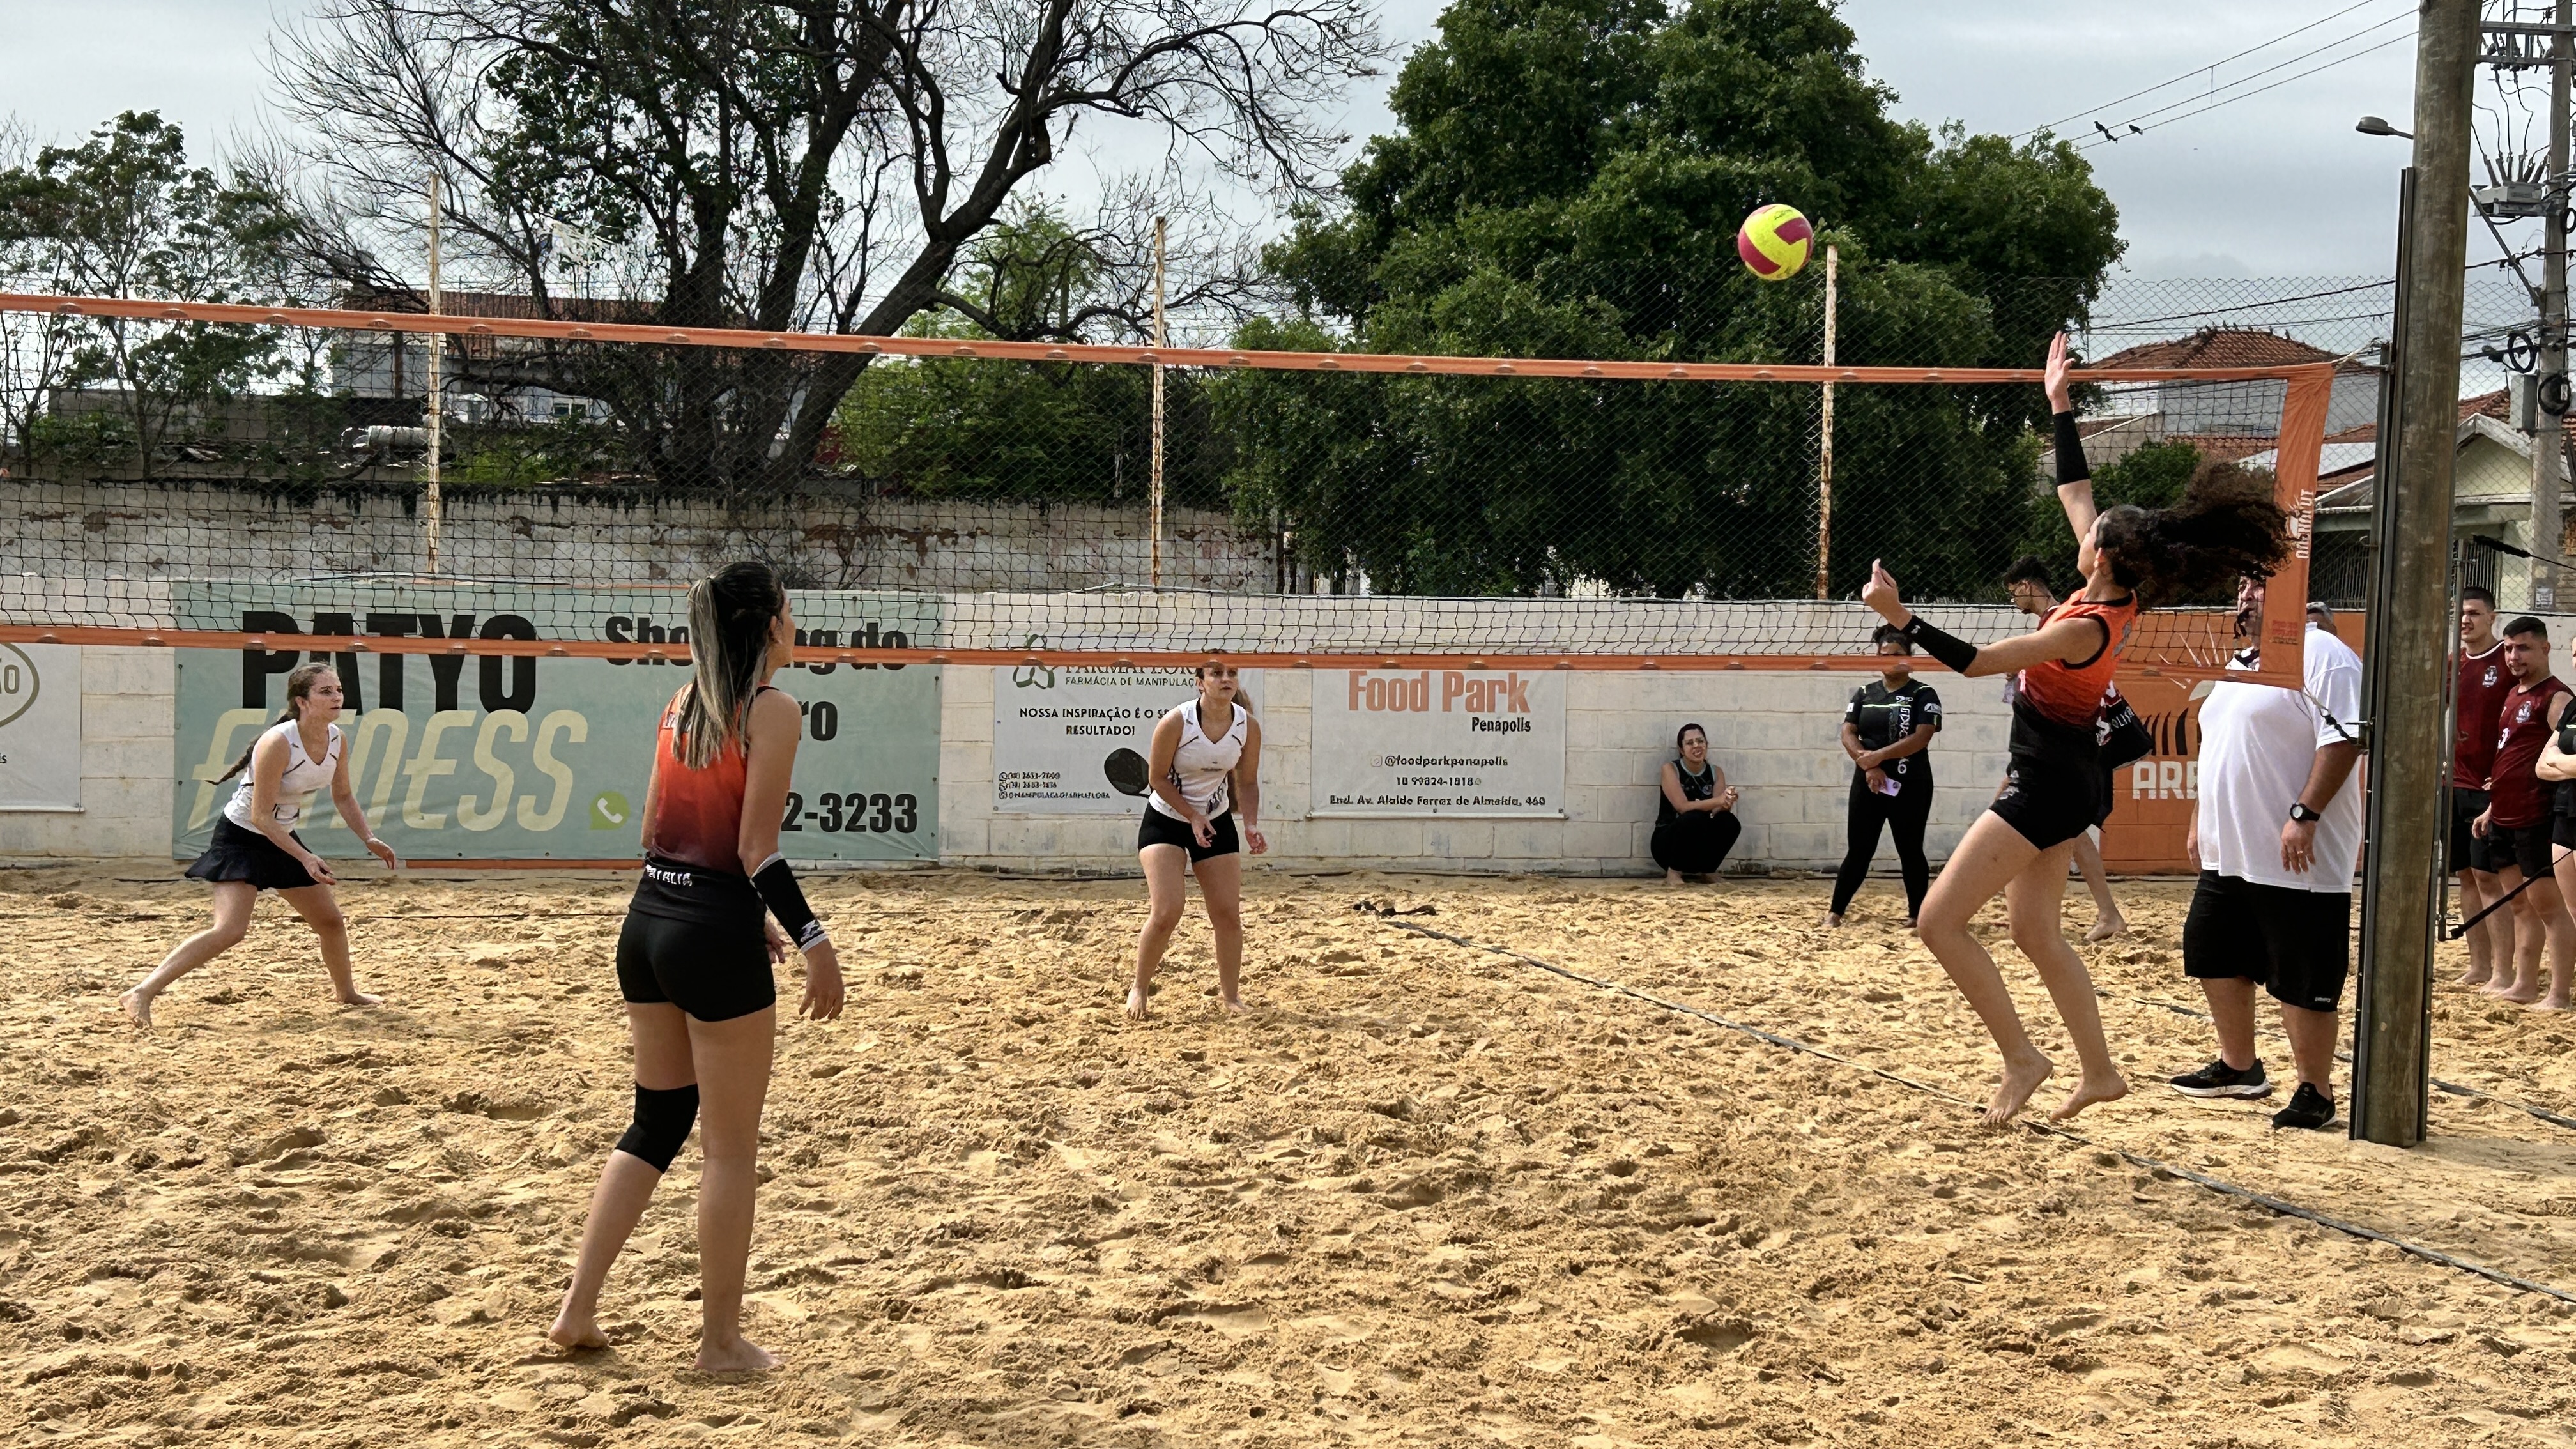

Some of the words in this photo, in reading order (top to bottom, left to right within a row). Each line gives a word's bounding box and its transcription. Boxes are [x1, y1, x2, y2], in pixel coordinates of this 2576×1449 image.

[850, 622, 908, 671] do
[1065, 676, 1117, 686] FARMÁCIA
[1136, 678, 1198, 689] MANIPULAÇ
[1349, 670, 1429, 712] Food
[1442, 671, 1531, 714] Park
[1020, 707, 1059, 718] NOSSA
[1062, 706, 1131, 722] INSPIRAÇÃO
[1144, 709, 1154, 719] O
[2133, 760, 2198, 799] ARE
[781, 792, 917, 834] 2-3233
[1456, 795, 1469, 806] de
